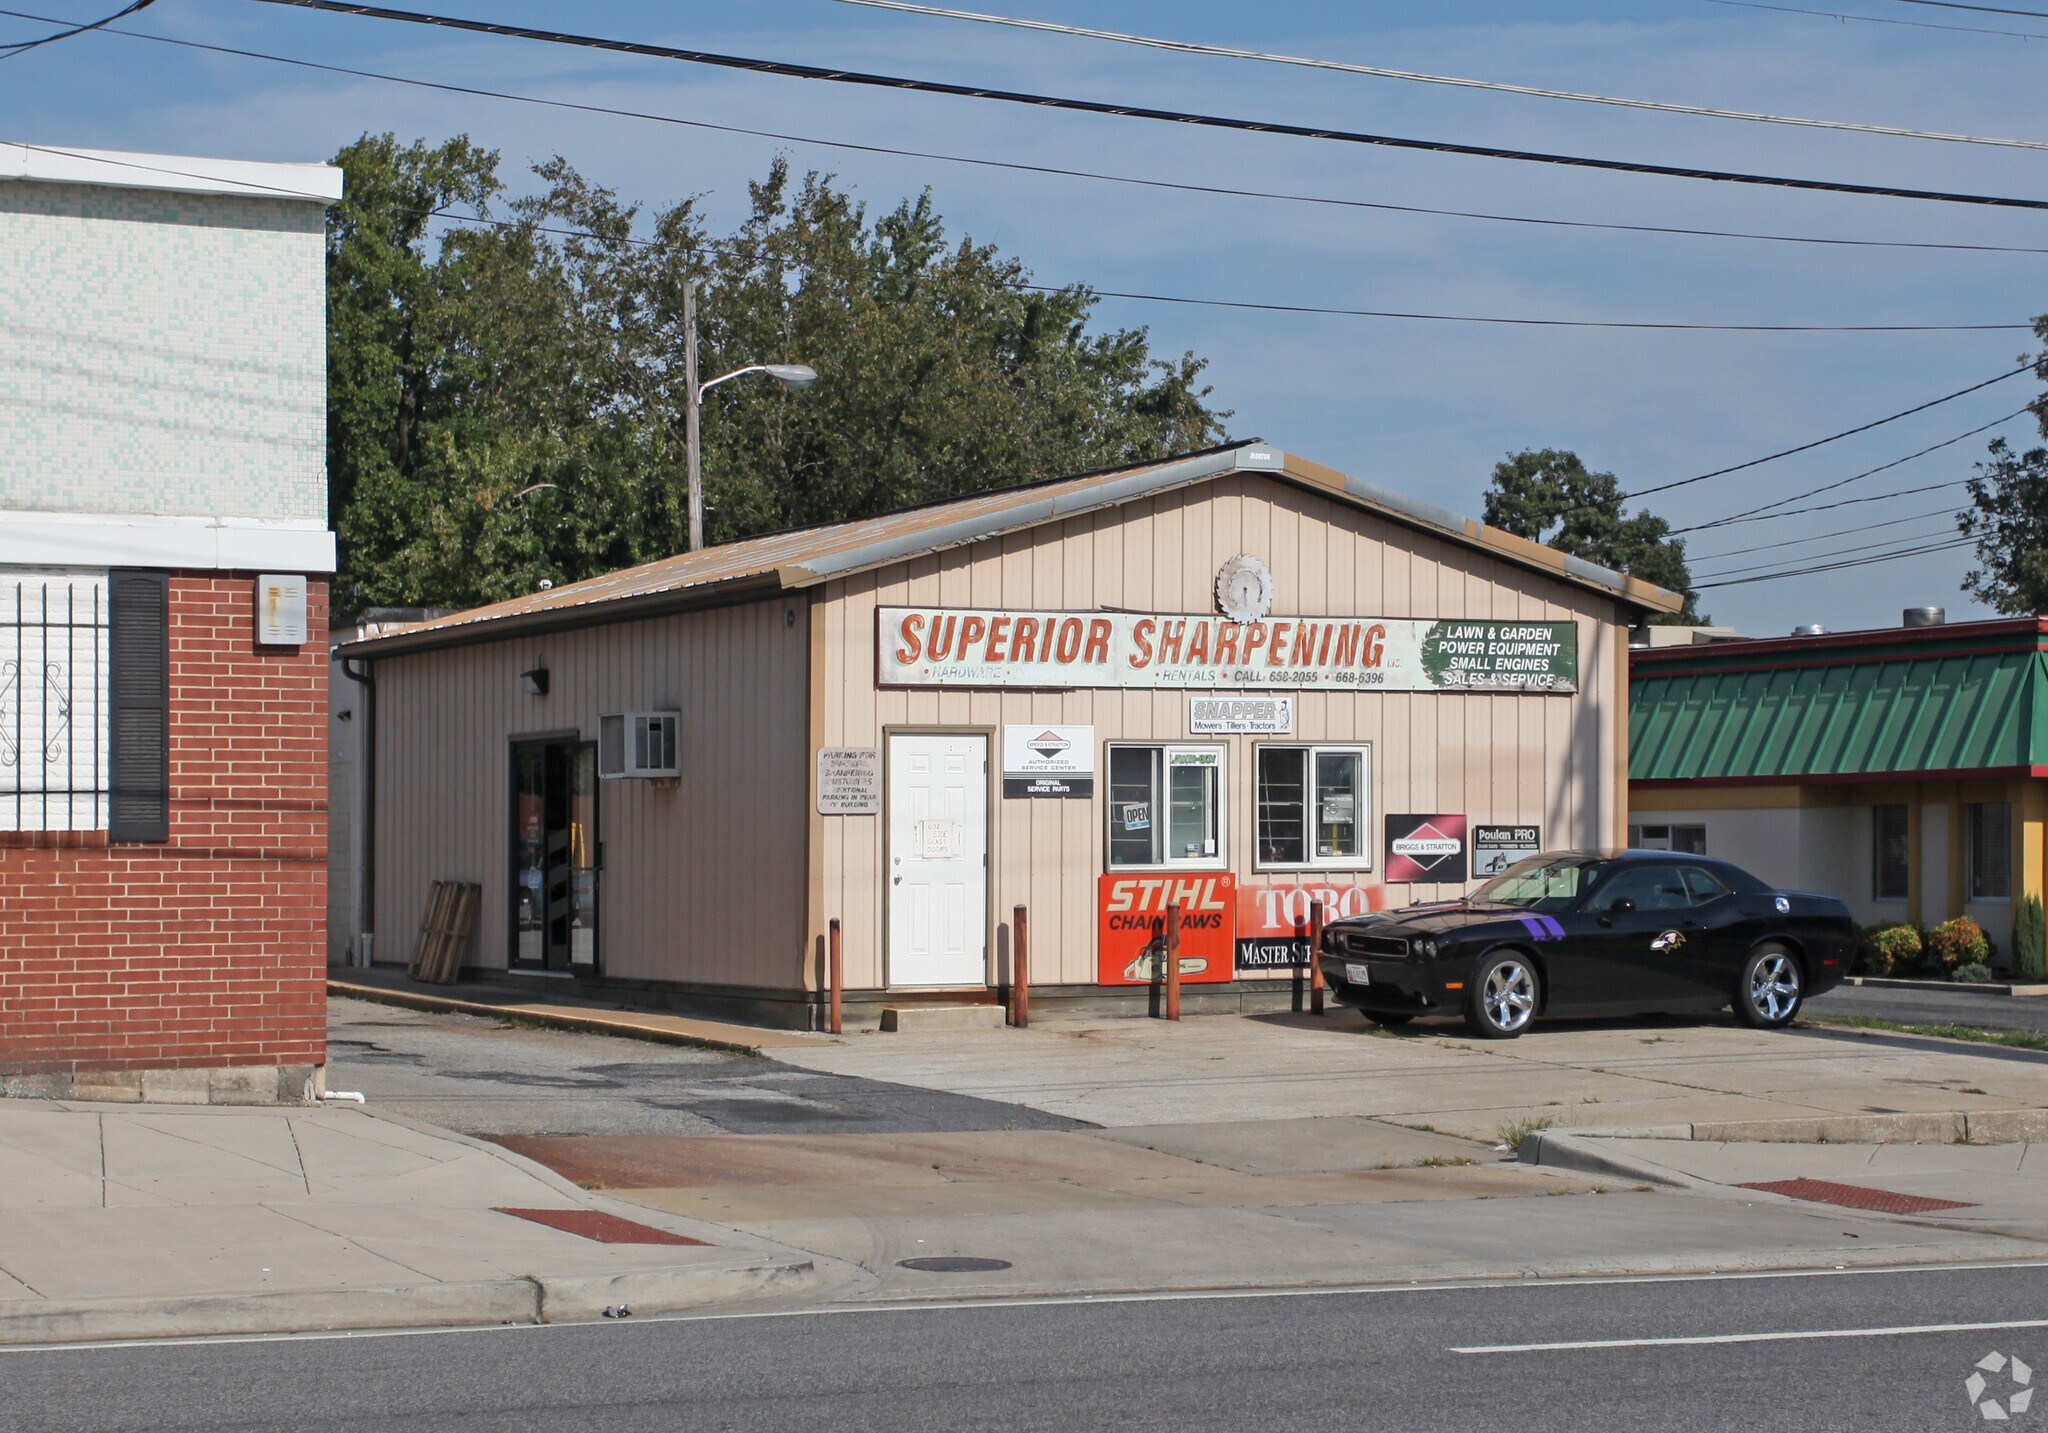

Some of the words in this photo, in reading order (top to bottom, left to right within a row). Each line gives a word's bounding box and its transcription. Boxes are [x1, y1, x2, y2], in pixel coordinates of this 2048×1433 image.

[895, 613, 1113, 666] SUPERIOR
[1128, 618, 1387, 669] SHARPENING
[1446, 626, 1484, 639] LAWN
[1487, 627, 1496, 640] &
[1500, 627, 1553, 641] GARDEN
[1438, 641, 1485, 655] POWER
[1488, 642, 1561, 656] EQUIPMENT
[1449, 657, 1491, 670] SMALL
[1495, 658, 1550, 671] ENGINES
[1162, 670, 1216, 682] RENTALS
[1336, 671, 1385, 684] 668-6396
[1443, 672, 1486, 686] SALES
[1501, 673, 1554, 687] SERVICE
[1194, 702, 1276, 720] SNAPPER
[1194, 721, 1222, 730] Mowers
[1226, 721, 1247, 730] Tillers
[1249, 721, 1276, 730] Tractors
[1126, 807, 1149, 823] OPEN
[1479, 829, 1511, 840] Poulan
[1514, 829, 1536, 840] PRO
[1396, 843, 1420, 851] BRIGGS
[1426, 843, 1457, 851] STRATTON
[1106, 878, 1225, 912] STIHL
[1256, 887, 1370, 929] TORO
[1109, 914, 1166, 930] CHAIN
[1178, 913, 1223, 929] AWS
[1241, 942, 1290, 965] MASTER
